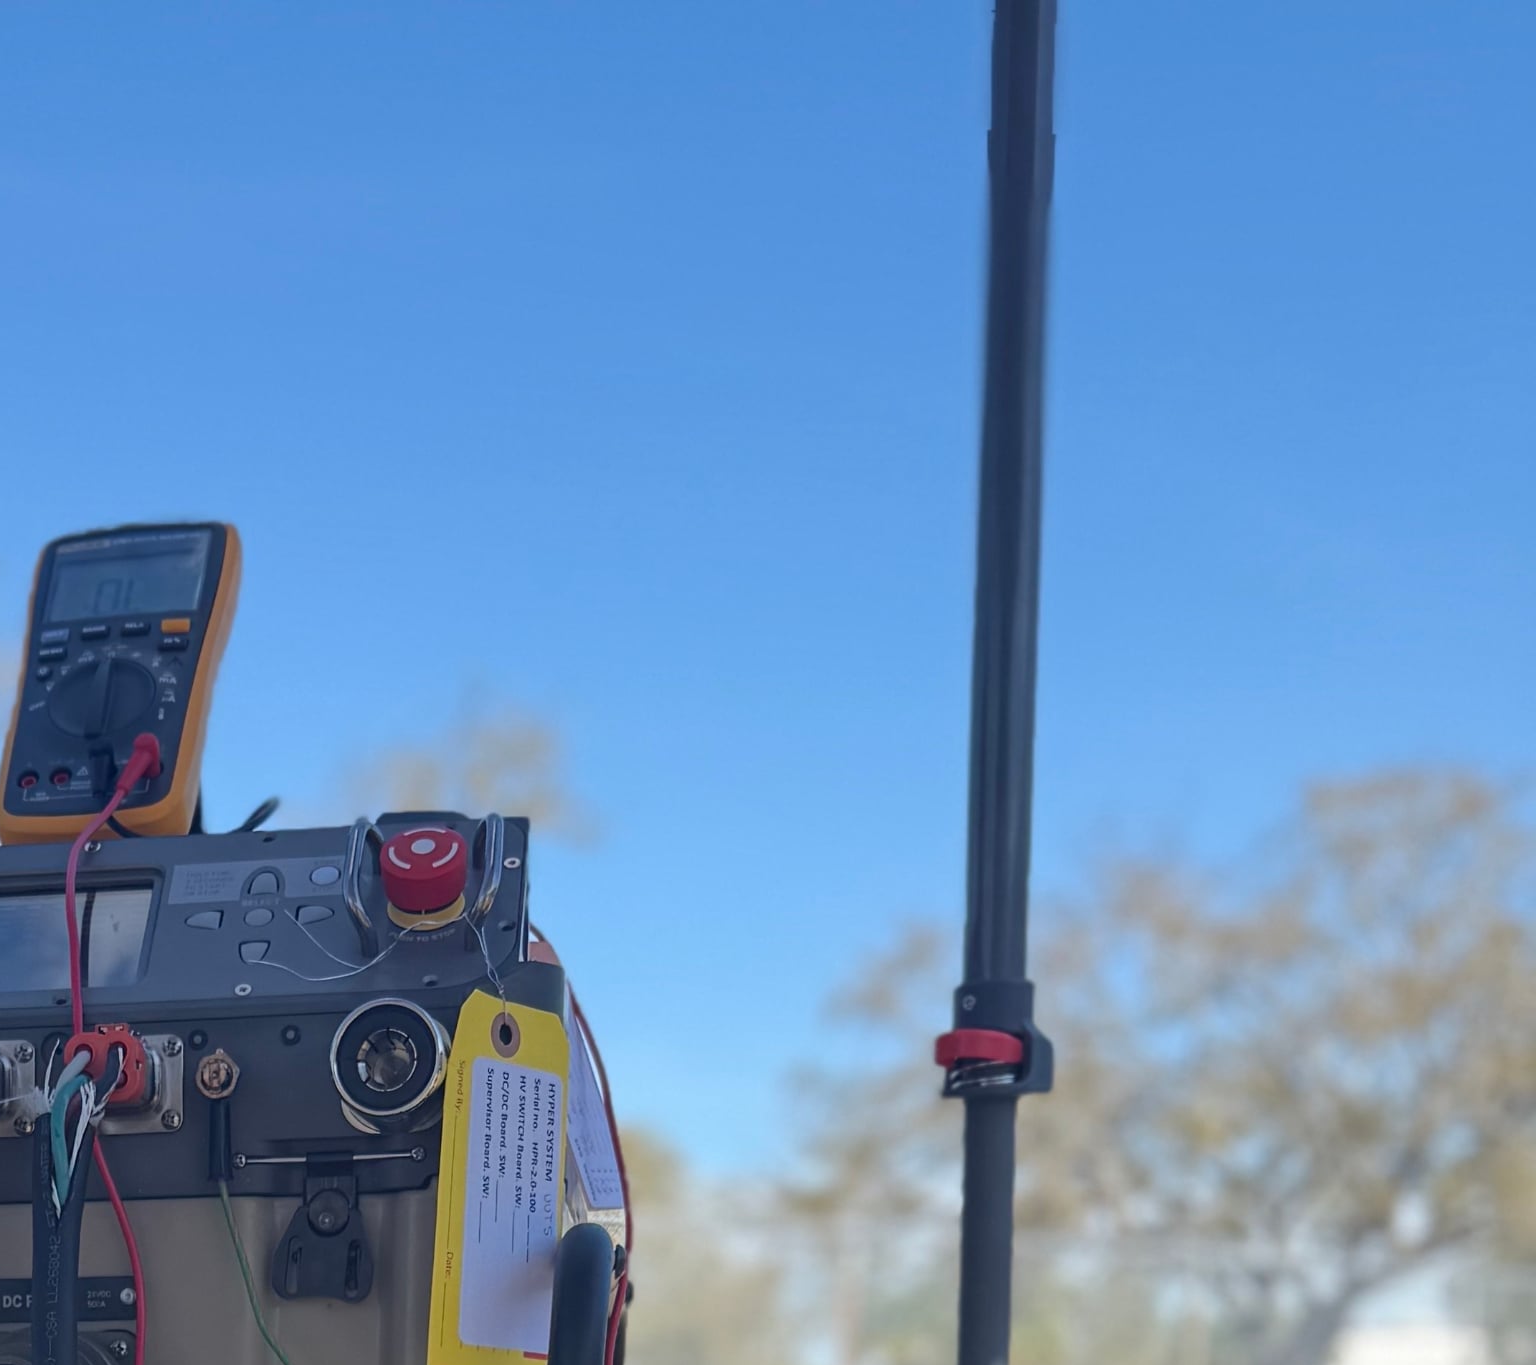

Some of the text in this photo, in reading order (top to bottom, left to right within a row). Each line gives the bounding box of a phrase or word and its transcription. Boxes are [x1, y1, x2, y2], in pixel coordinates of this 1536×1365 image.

[518, 1075, 527, 1091] HV
[517, 1094, 526, 1142] SWITCH
[544, 1083, 556, 1182] HYPER SYSTEM
[2, 1295, 23, 1308] DC
